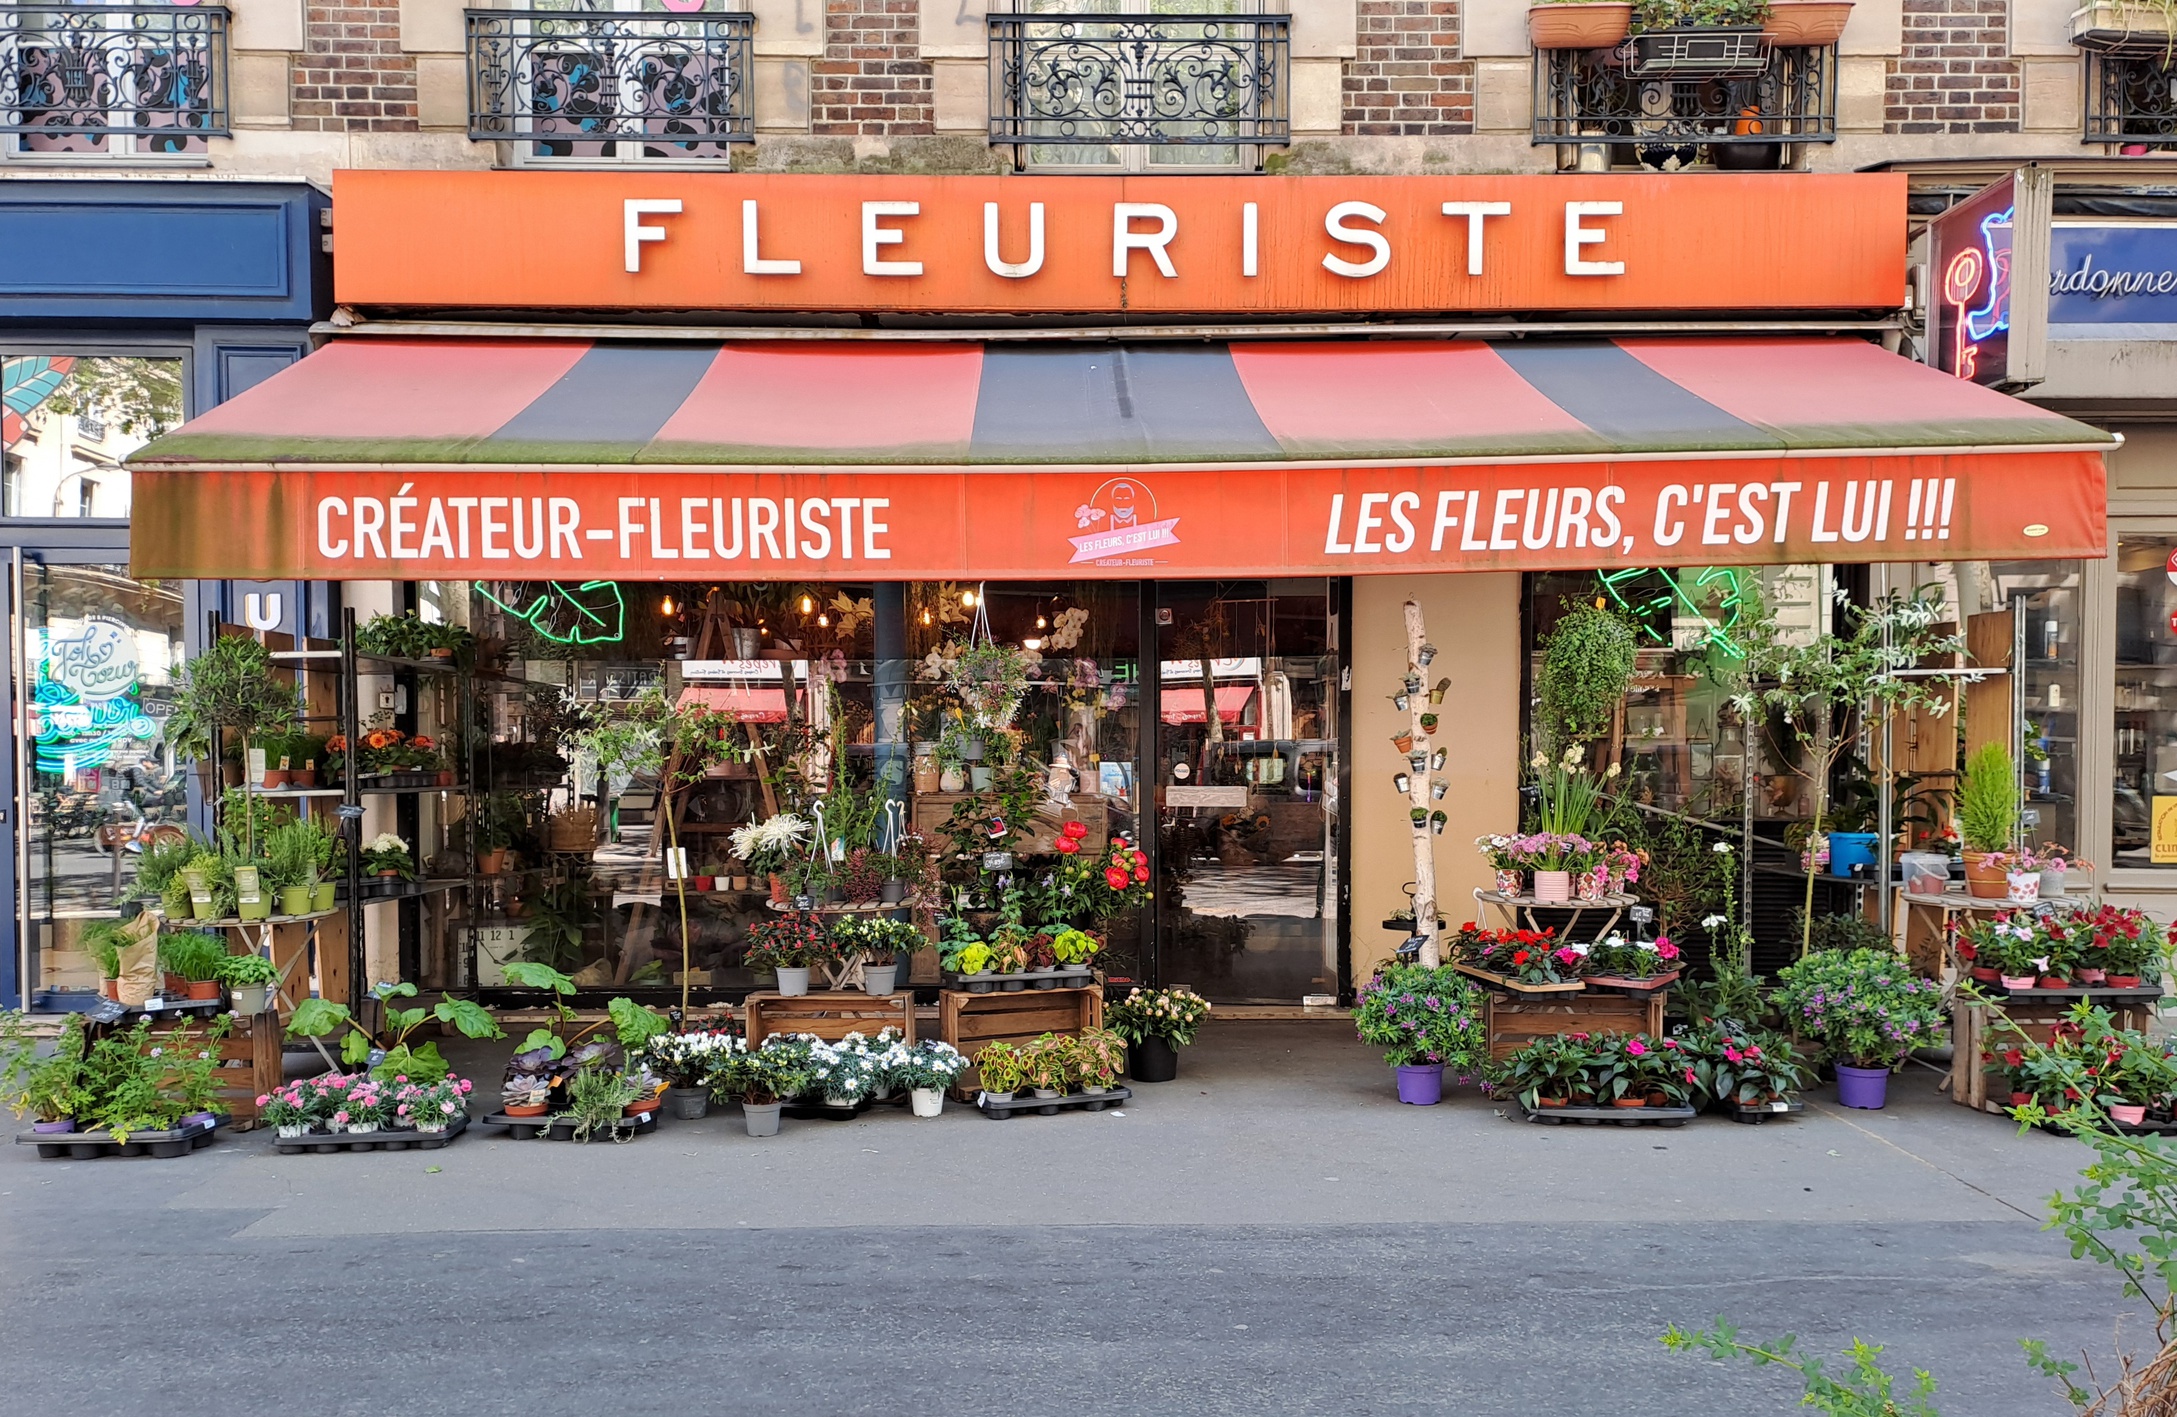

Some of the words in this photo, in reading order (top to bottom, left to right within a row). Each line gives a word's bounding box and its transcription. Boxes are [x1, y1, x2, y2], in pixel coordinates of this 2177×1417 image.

[624, 198, 1625, 279] FLEURISTE
[2049, 253, 2177, 298] rdonne
[317, 482, 891, 559] CRÉATEUR-FLEURISTE
[1079, 541, 1093, 553] LES
[1095, 536, 1125, 550] FLEURS,
[1126, 531, 1147, 544] C'EST
[1148, 528, 1161, 540] LUI
[1324, 491, 1420, 554] LES
[1430, 485, 1635, 555] FLEURS,
[1653, 481, 1802, 547] C'EST
[1810, 479, 1893, 543] LUI
